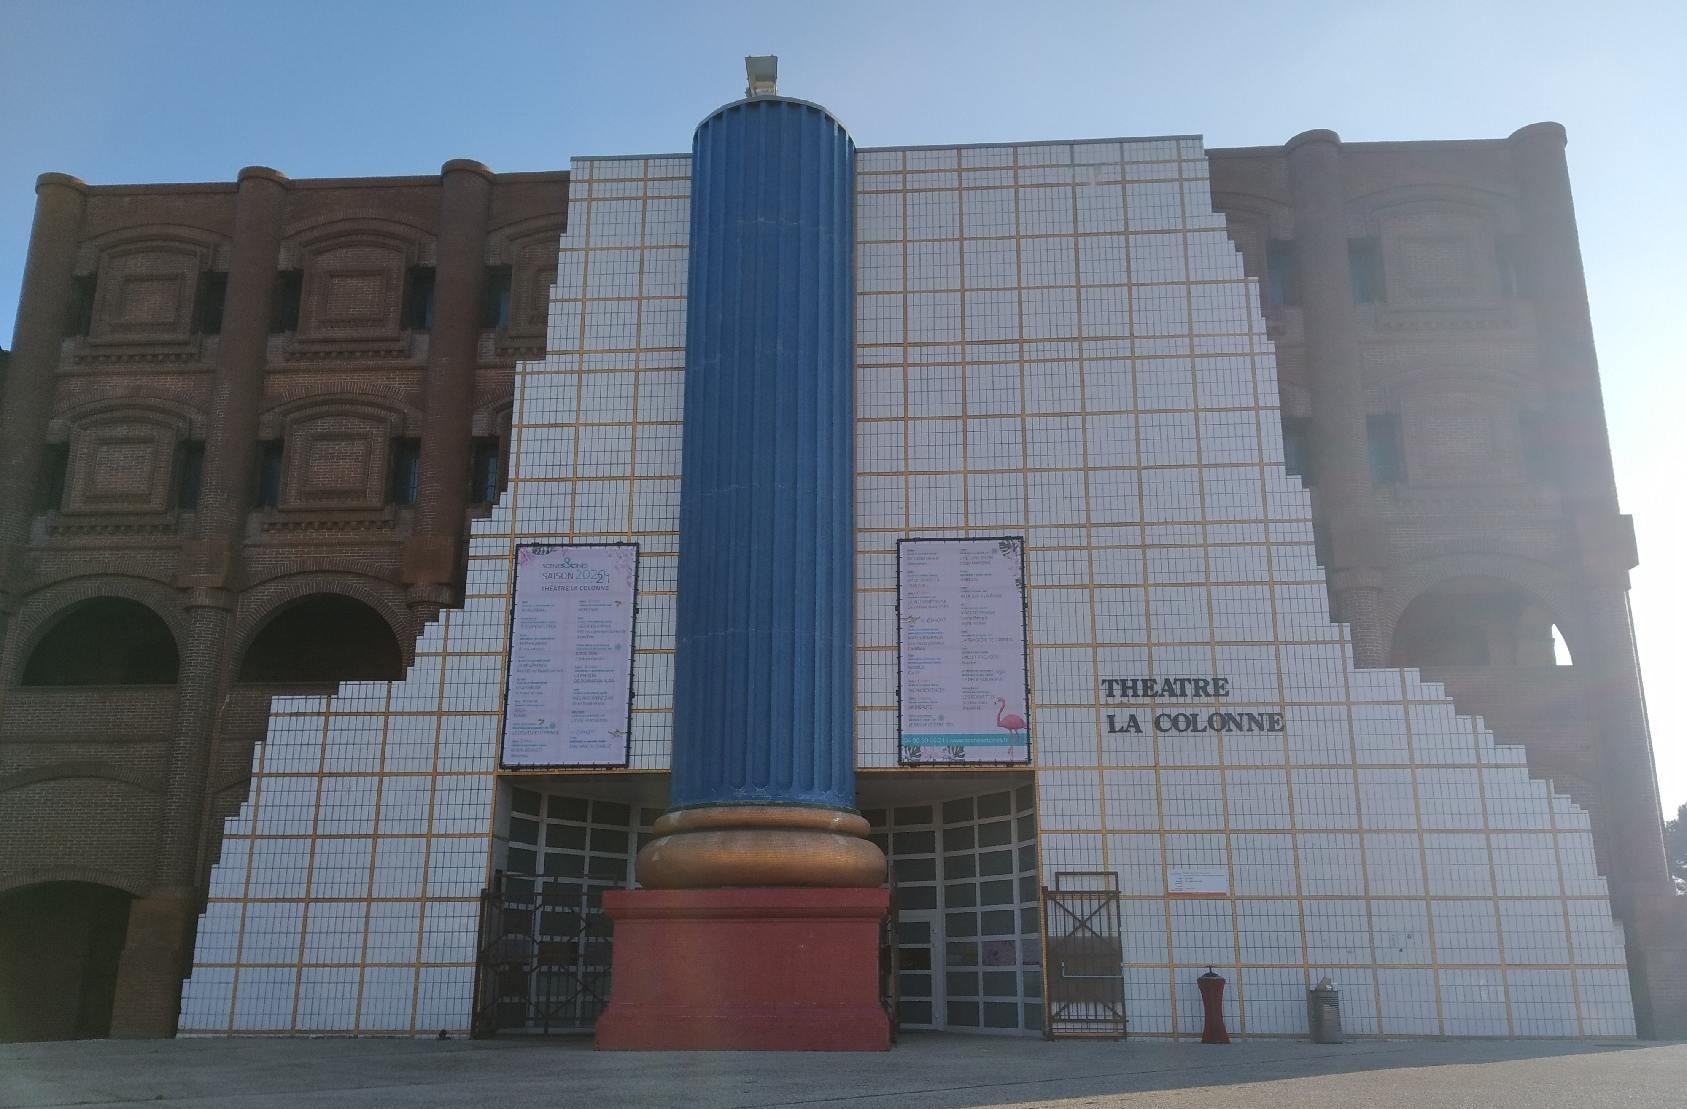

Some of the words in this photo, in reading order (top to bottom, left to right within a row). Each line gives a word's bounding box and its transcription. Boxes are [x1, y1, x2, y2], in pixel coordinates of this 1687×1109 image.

[542, 572, 574, 580] SAISON
[1101, 677, 1230, 697] THEATRE
[1106, 713, 1144, 734] LA
[1154, 712, 1285, 733] COLONNE
